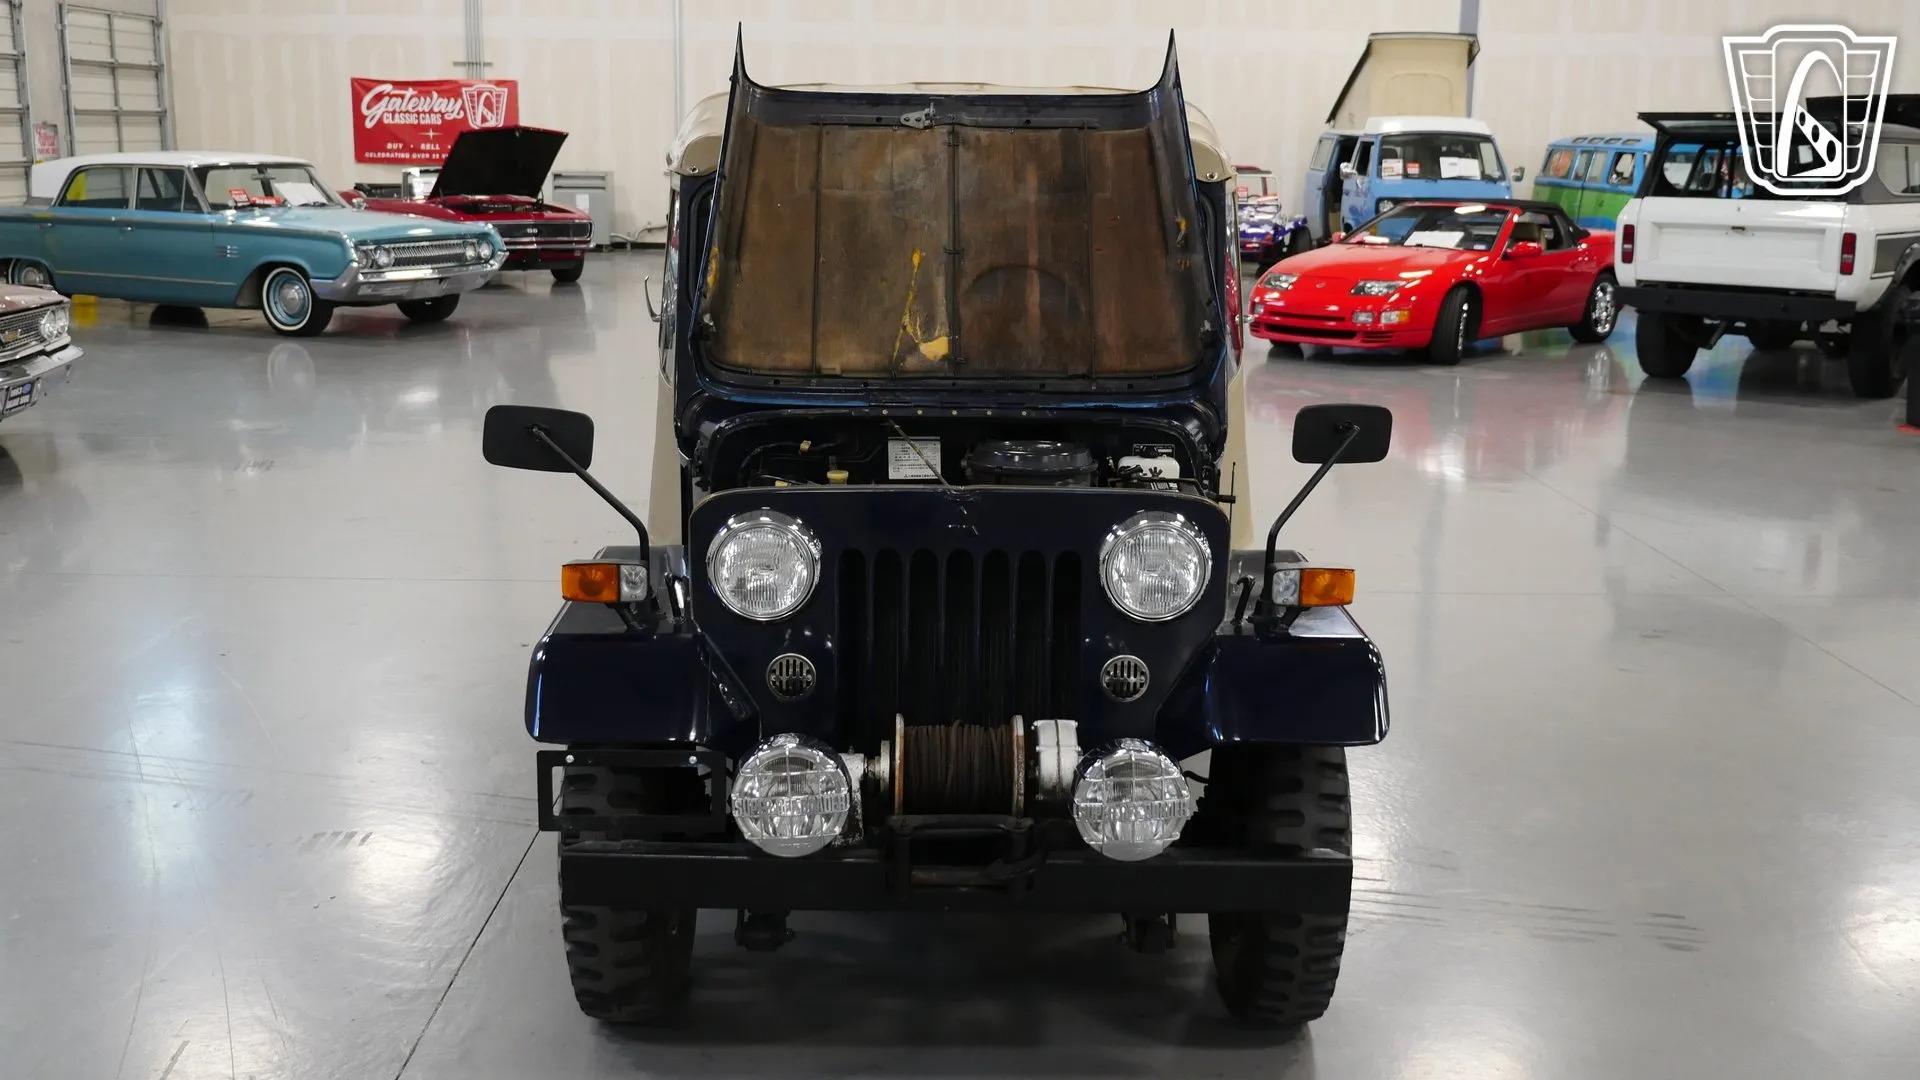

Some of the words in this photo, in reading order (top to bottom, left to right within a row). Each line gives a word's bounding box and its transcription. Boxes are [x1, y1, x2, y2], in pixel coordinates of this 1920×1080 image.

[361, 83, 464, 129] Gateway
[383, 112, 418, 124] CLASSIC
[419, 113, 442, 125] CARS
